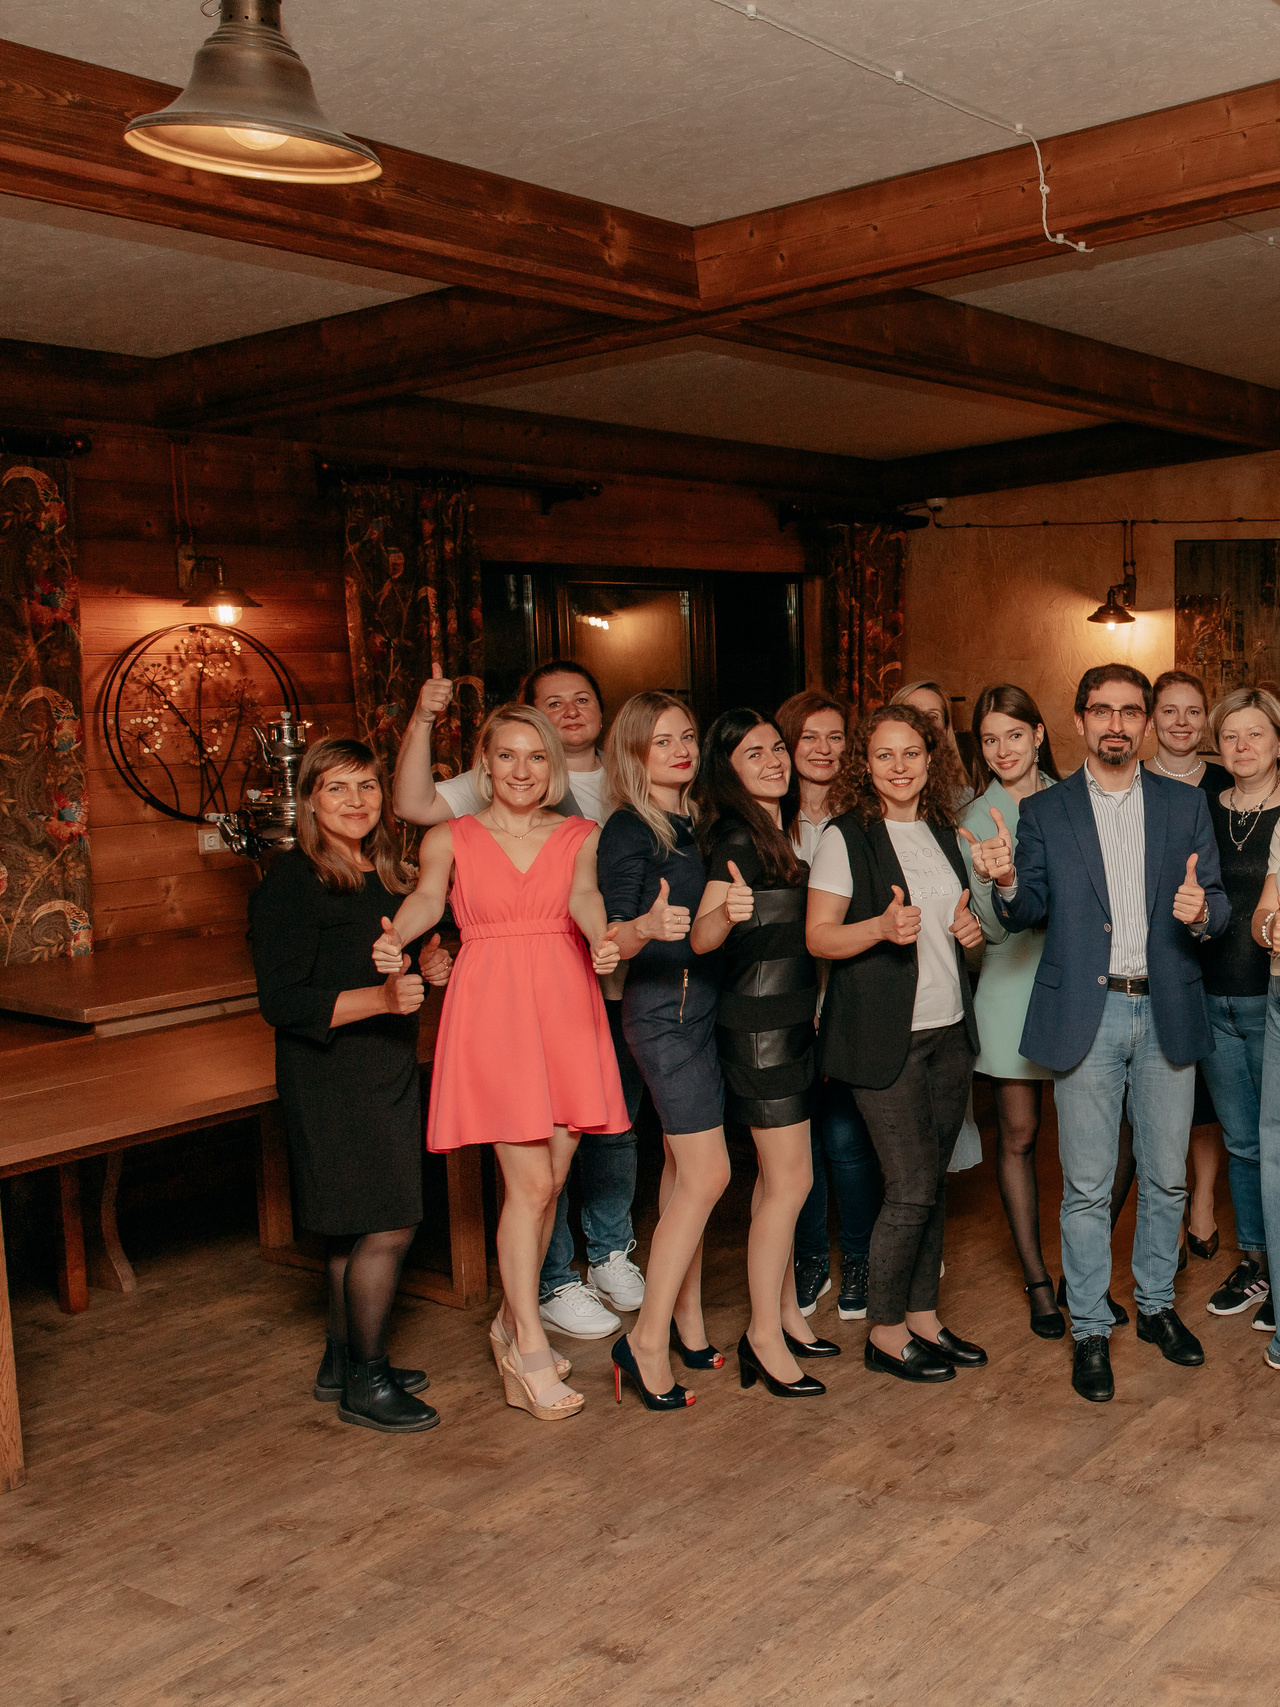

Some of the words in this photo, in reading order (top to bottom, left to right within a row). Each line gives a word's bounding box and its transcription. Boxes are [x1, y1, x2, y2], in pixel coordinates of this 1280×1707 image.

[900, 846, 945, 863] EYON
[911, 863, 952, 879] THIS
[910, 882, 961, 900] REALIT
